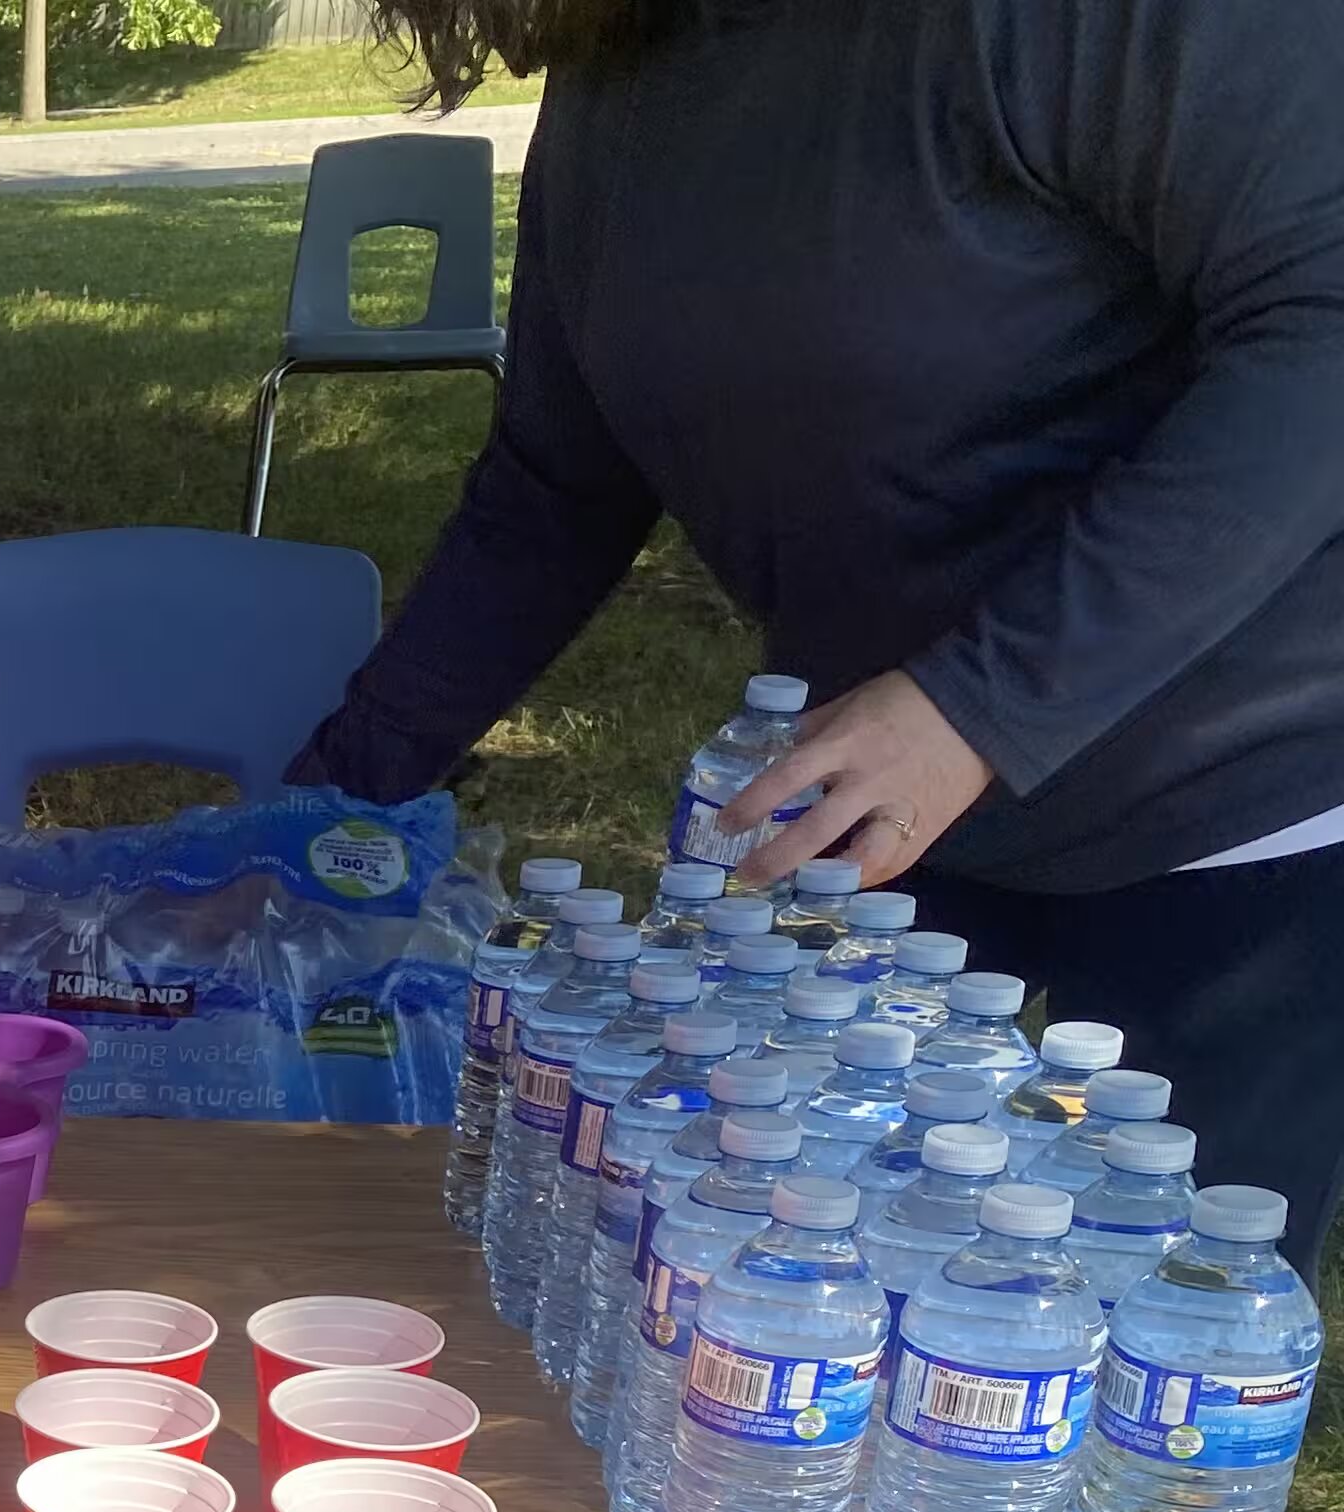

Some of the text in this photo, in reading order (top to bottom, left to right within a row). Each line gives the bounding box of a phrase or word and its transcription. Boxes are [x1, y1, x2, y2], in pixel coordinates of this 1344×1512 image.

[56, 974, 188, 1006] KIRKLAND
[87, 1039, 265, 1068] pring water
[63, 1080, 287, 1110] ource naturelle
[1243, 1380, 1302, 1398] KIRKLAND
[1201, 1425, 1226, 1435] eau
[1229, 1424, 1245, 1435] de
